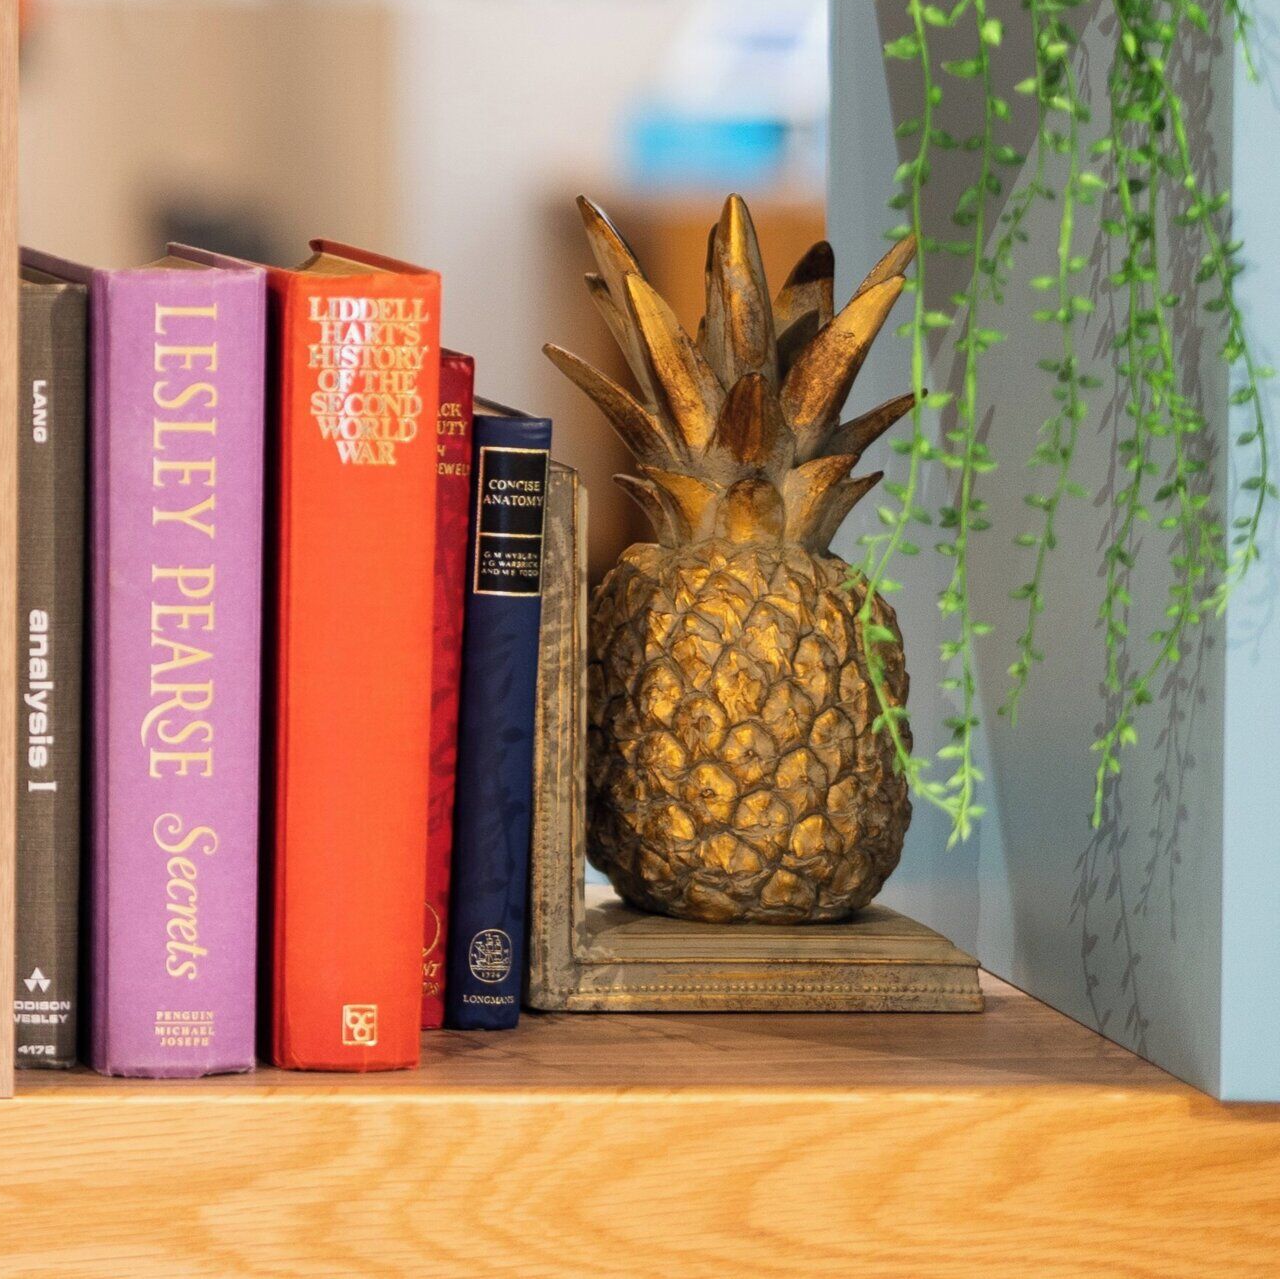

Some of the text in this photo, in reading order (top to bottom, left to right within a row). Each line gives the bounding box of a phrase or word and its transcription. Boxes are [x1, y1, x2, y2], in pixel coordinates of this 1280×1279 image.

[307, 296, 430, 322] LIDDELL
[306, 344, 430, 370] HISTORY
[317, 369, 420, 395] OF THE
[32, 380, 48, 443] LANG
[309, 391, 424, 418] SECOND
[316, 415, 418, 443] WORLD
[336, 440, 398, 466] WAR
[488, 479, 540, 492] CONCISE
[483, 494, 544, 507] ANATOMY
[140, 301, 219, 779] LESLEY PEARSE
[23, 608, 55, 769] analysis
[152, 812, 219, 981] Secrets
[13, 1000, 71, 1011] DDISON
[463, 994, 515, 1005] LONGMANS
[156, 1010, 214, 1020] PENGUIN
[154, 1026, 215, 1036] MICHAEL
[160, 1036, 209, 1047] JOSEPH
[18, 1044, 56, 1055] 4172
